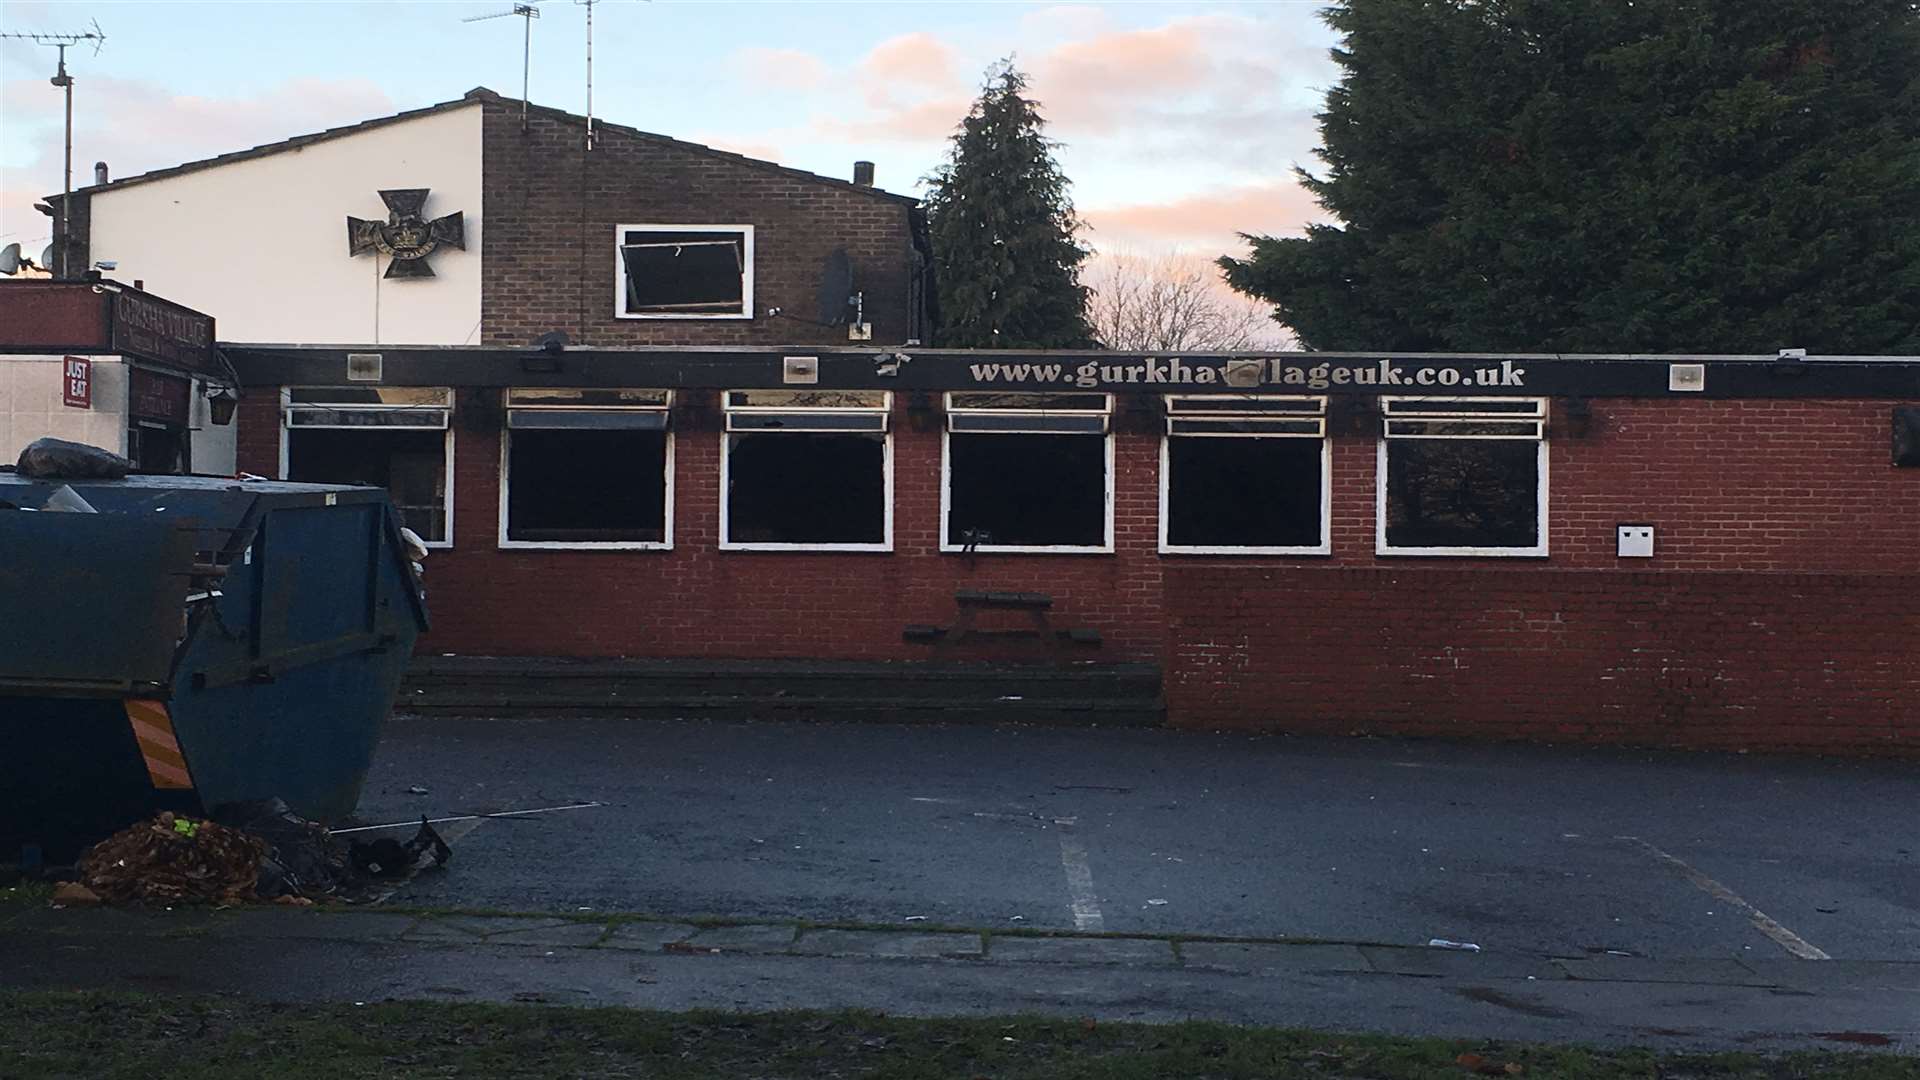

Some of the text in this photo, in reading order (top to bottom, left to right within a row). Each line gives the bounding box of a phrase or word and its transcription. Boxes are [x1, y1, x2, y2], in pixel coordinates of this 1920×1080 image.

[66, 360, 87, 379] JUST
[970, 357, 1525, 388] www.gurkhavllageuk.co.uk
[71, 379, 88, 398] EAT
